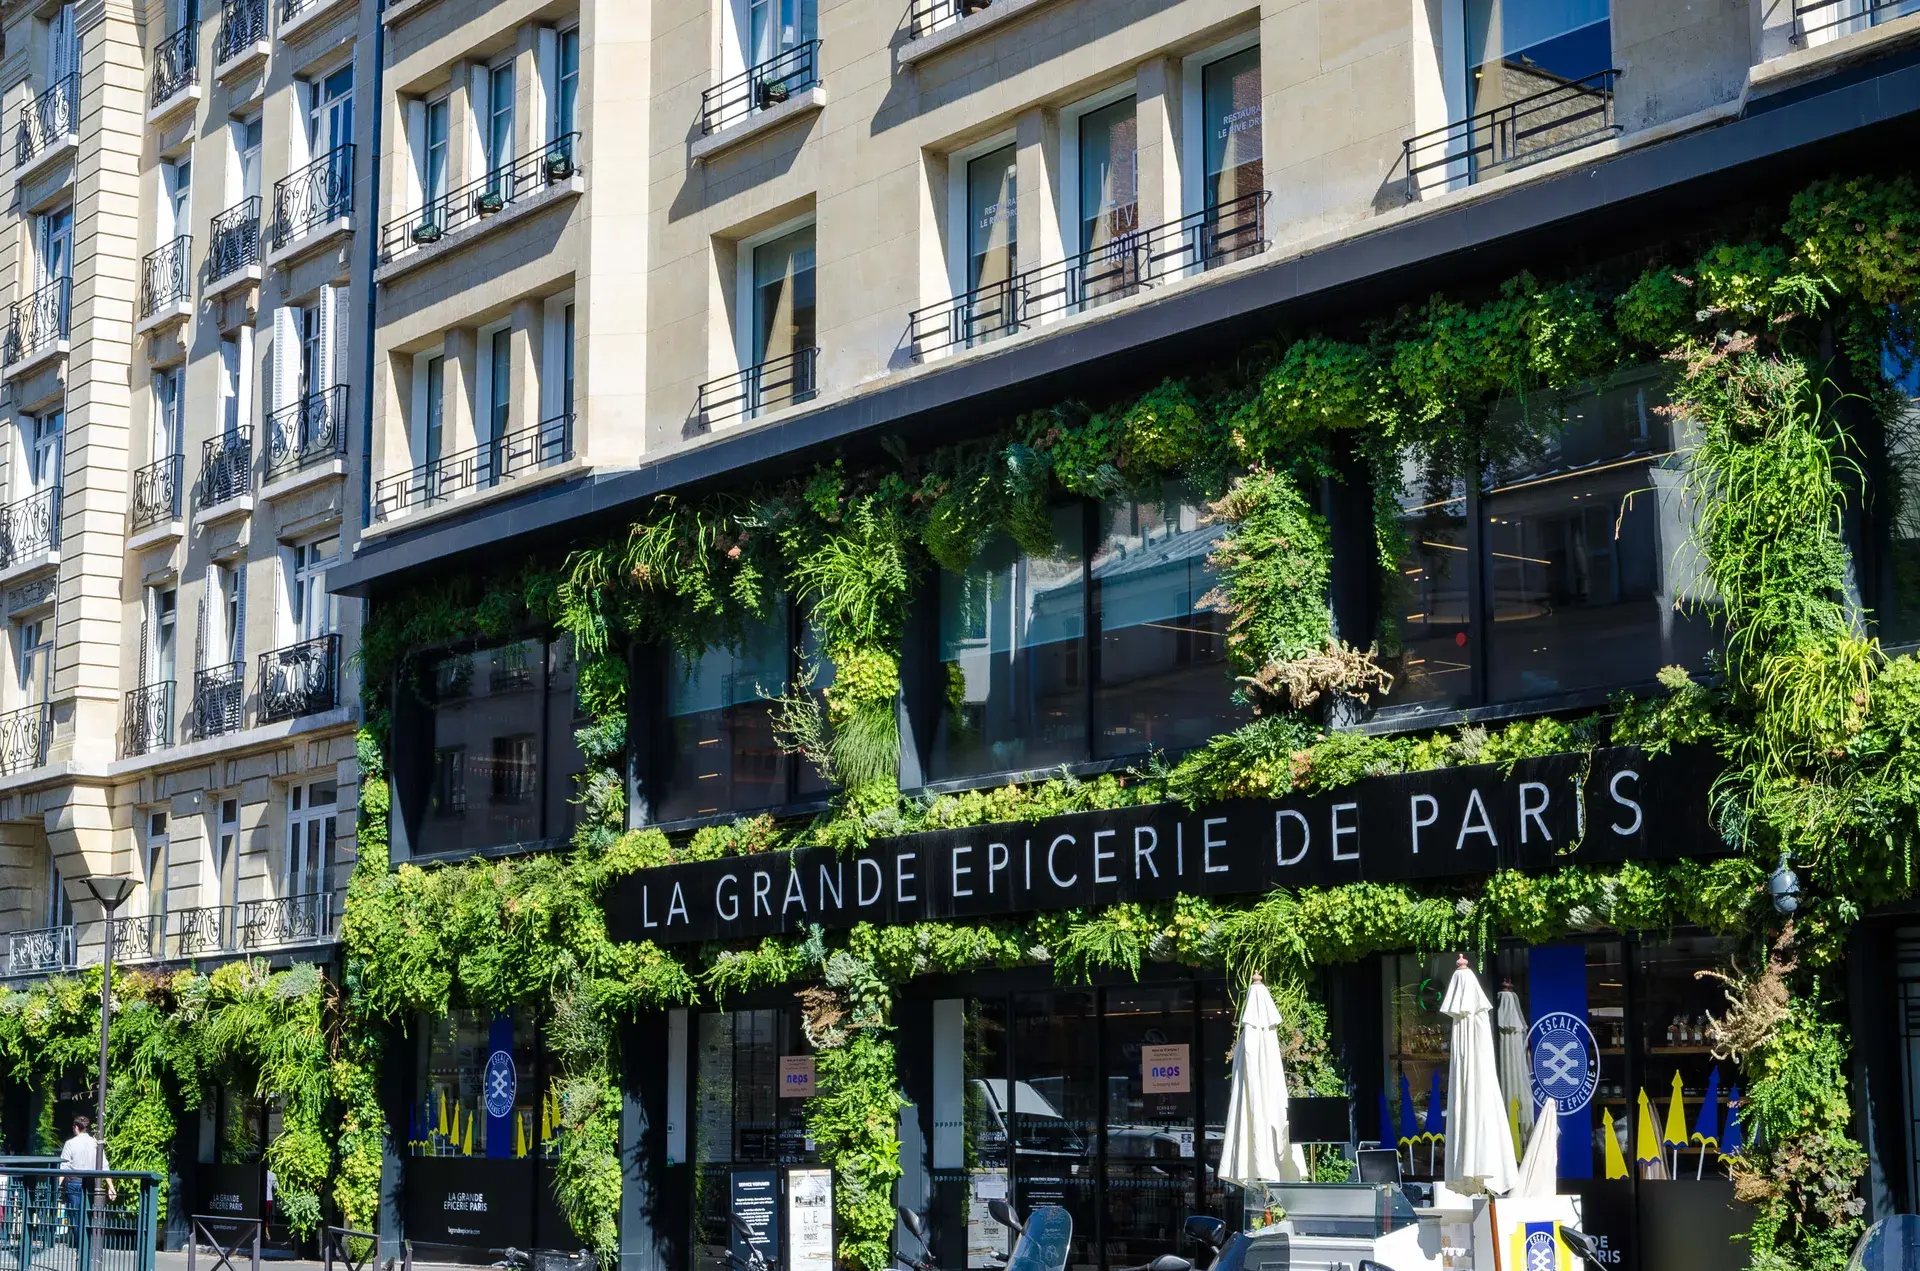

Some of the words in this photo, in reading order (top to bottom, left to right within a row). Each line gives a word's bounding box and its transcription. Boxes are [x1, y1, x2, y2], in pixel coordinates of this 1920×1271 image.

[1223, 104, 1262, 125] RESTAURA
[1218, 129, 1227, 139] LE
[1229, 122, 1246, 134] RIVE
[984, 197, 1016, 216] RESTAURA
[979, 218, 988, 228] LE
[1101, 202, 1134, 234] RIV
[1102, 229, 1139, 266] DROIT
[643, 881, 689, 928] LA
[716, 853, 916, 921] GRANDE
[952, 817, 1229, 897] EPICERIE
[1275, 802, 1359, 866] DE
[1411, 770, 1642, 854] PARIS
[1538, 1016, 1580, 1035] ESCALE
[1567, 1070, 1596, 1110] ÉPICERIE
[213, 1193, 219, 1202] LA
[220, 1194, 240, 1202] GRANDE
[448, 1192, 456, 1201] LA
[457, 1192, 483, 1203] GRANDE
[229, 1202, 243, 1211] PARIS
[443, 1201, 469, 1211] EPICERIE
[469, 1202, 488, 1212] PARIS
[1529, 1234, 1551, 1246] ESCALE
[1598, 1250, 1621, 1264] RIS
